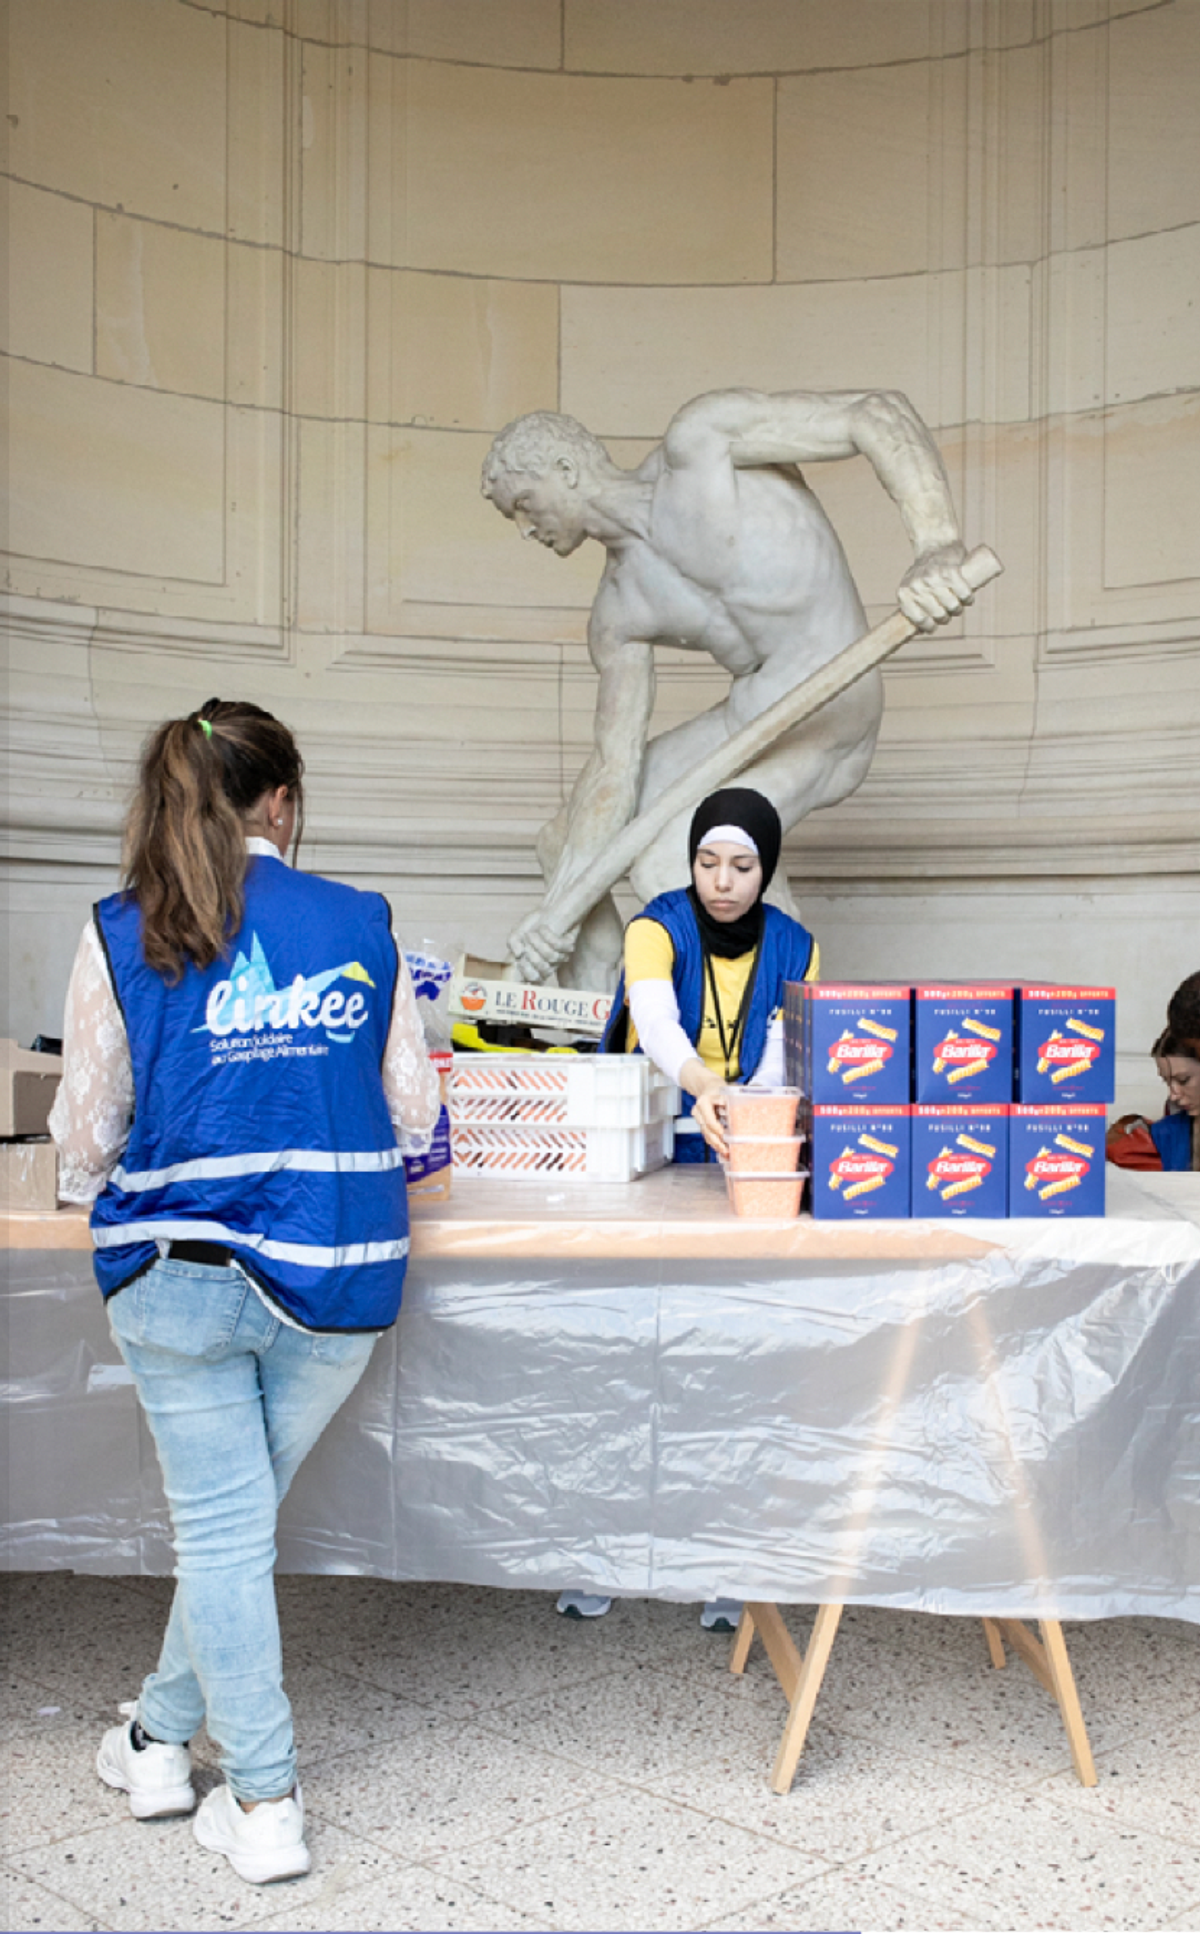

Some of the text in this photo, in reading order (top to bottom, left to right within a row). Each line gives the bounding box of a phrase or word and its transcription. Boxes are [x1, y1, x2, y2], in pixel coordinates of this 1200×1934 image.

[206, 974, 368, 1036] linkee
[495, 991, 518, 1009] LE
[521, 990, 588, 1018] ROUGE
[837, 1043, 887, 1058] Barilla
[941, 1043, 991, 1058] Barilla
[1046, 1043, 1095, 1058] Barilla
[837, 1160, 888, 1173] Barilla
[935, 1160, 986, 1173] Barilla
[1033, 1160, 1085, 1173] Barilla
